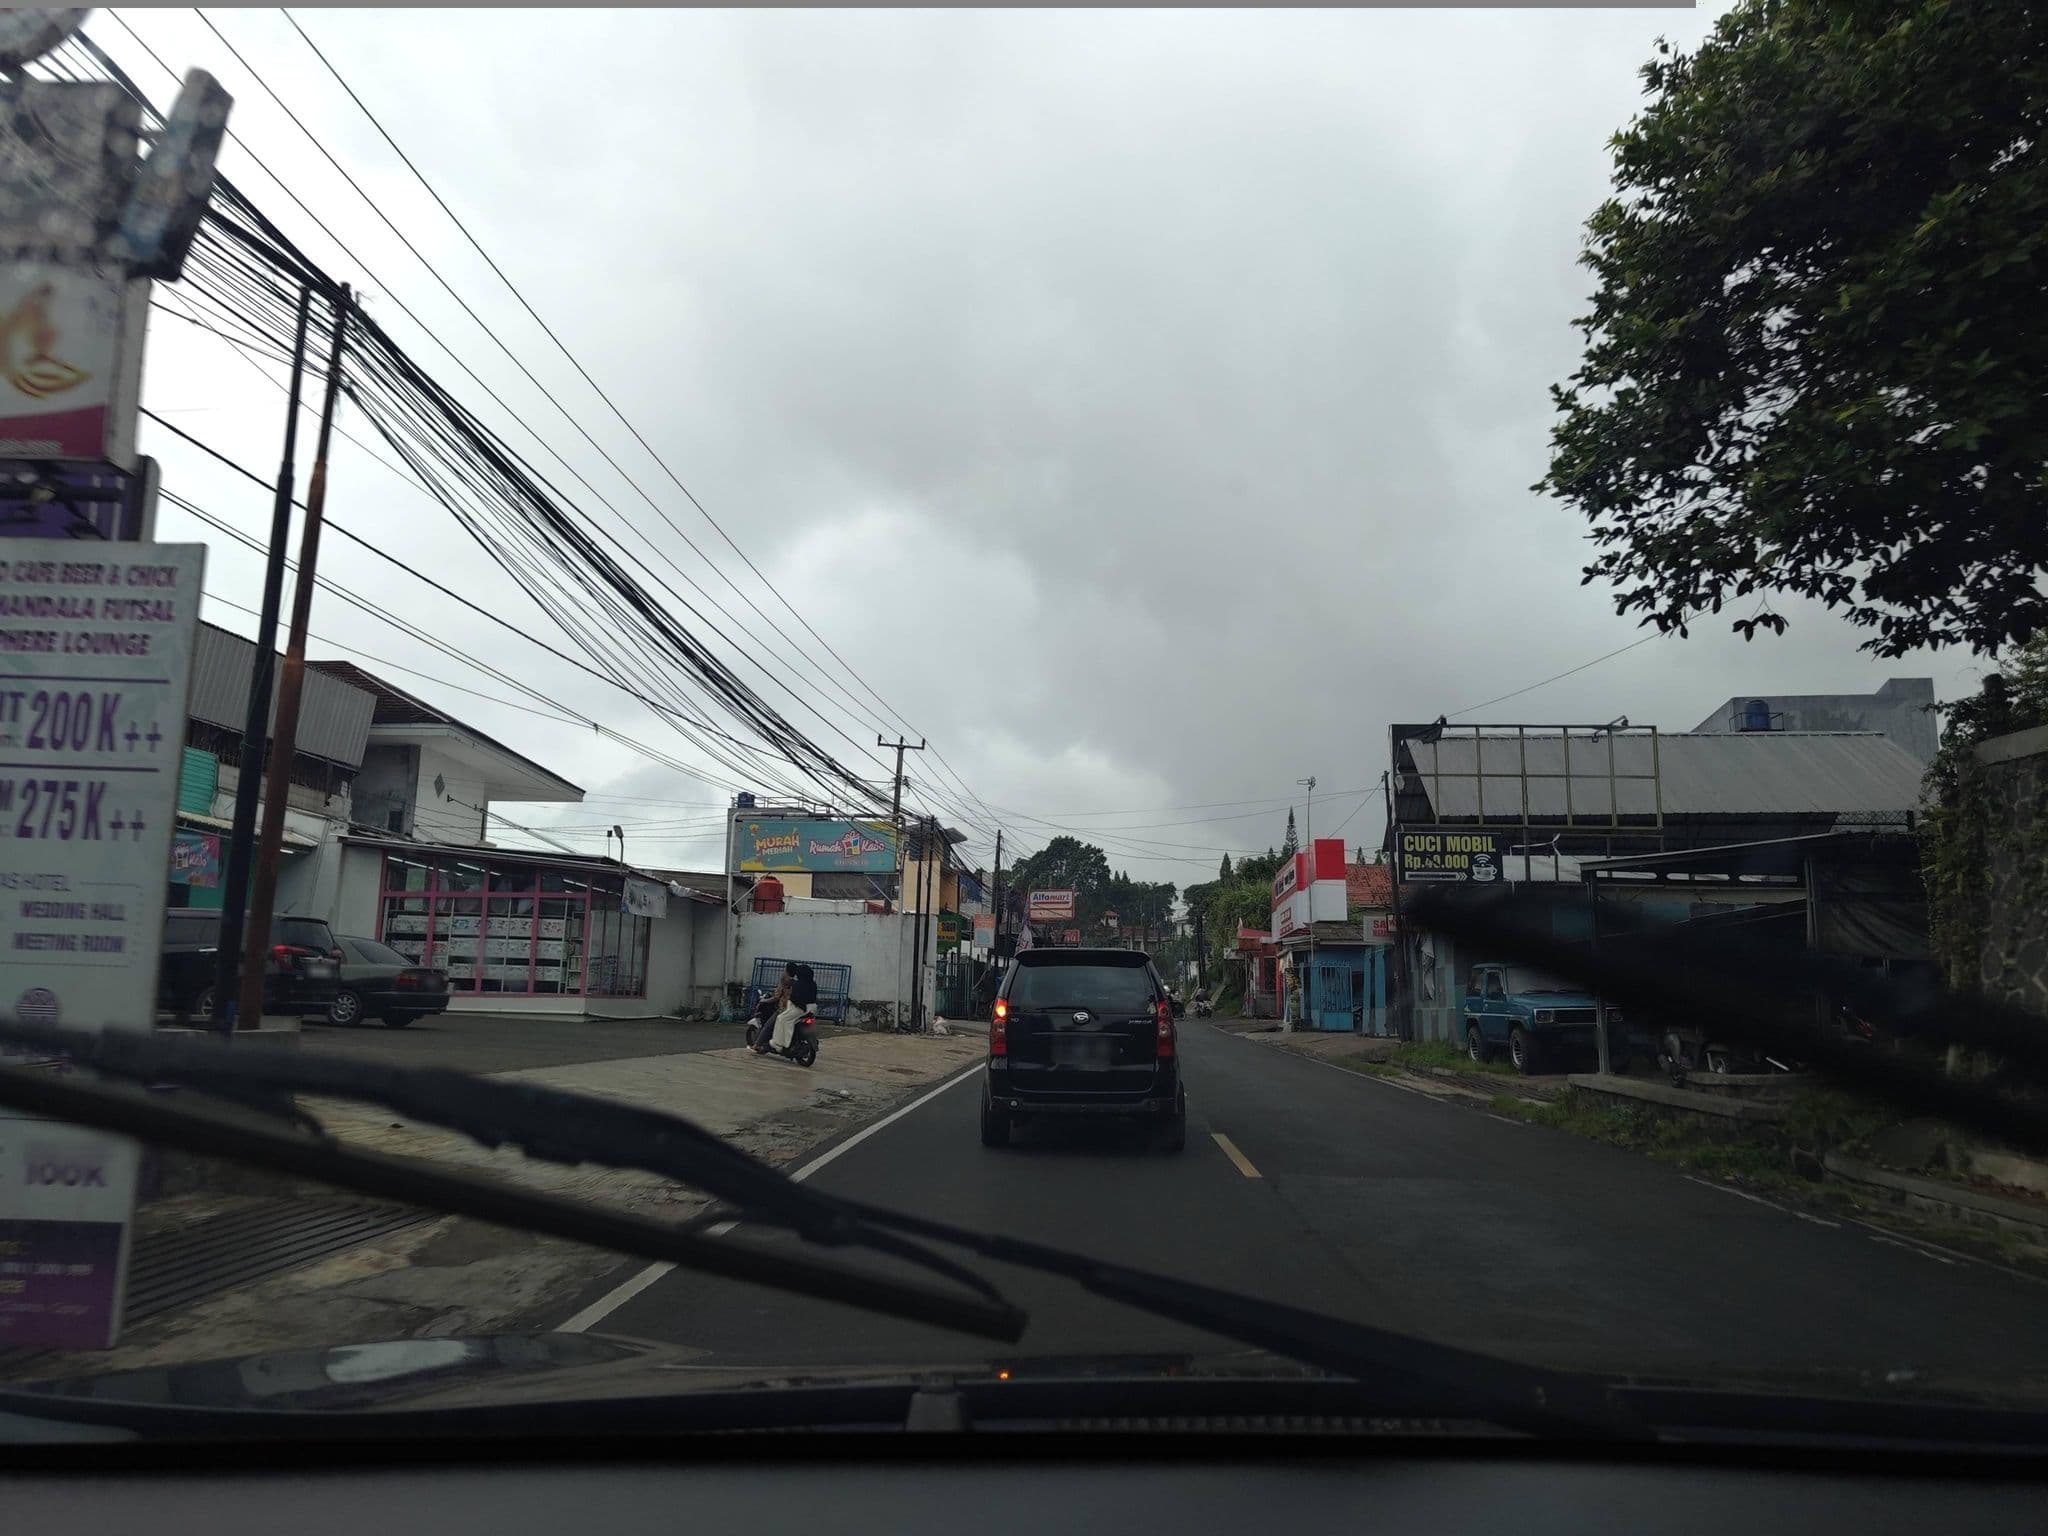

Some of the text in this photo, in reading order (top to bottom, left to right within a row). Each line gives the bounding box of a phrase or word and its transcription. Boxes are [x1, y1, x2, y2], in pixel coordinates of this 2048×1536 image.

[756, 834, 800, 850] MURAH
[1403, 835, 1497, 853] CUCI MOBIL
[1033, 892, 1071, 901] Alfamart
